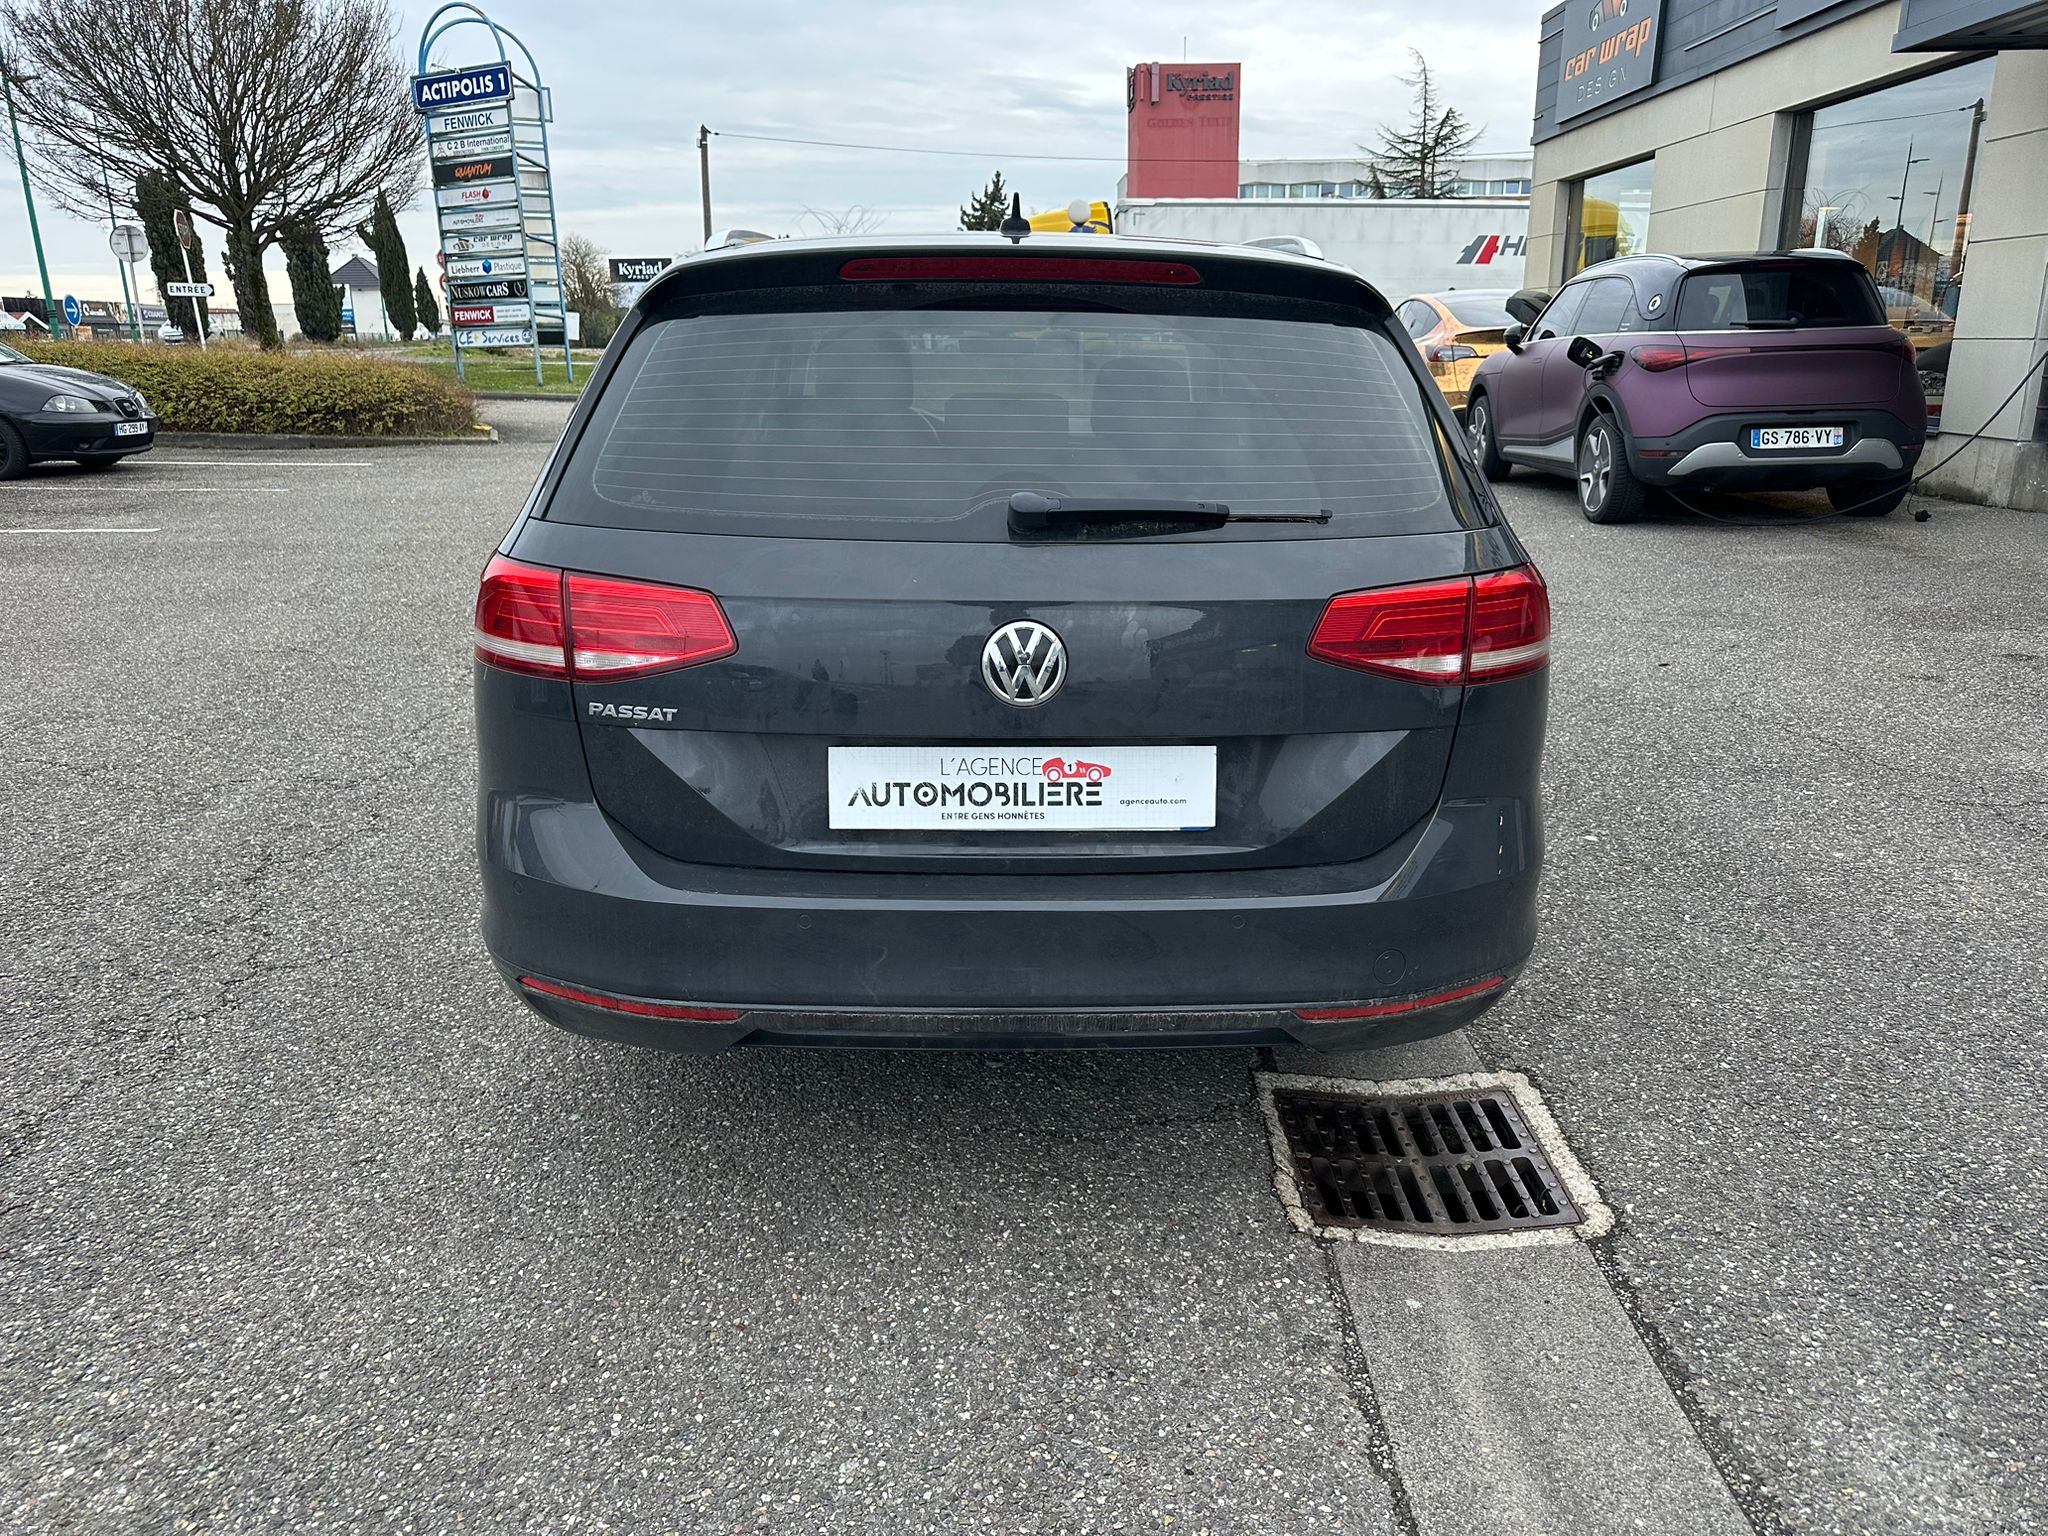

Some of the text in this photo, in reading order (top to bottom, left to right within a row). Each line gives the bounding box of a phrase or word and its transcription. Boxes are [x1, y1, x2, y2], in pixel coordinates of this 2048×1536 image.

[1564, 16, 1652, 81] car wrap
[421, 73, 506, 102] ACTIPOLIS 1
[1167, 71, 1233, 96] Kyriad
[1577, 65, 1627, 102] DESIGN
[444, 112, 494, 131] FENWICK
[467, 135, 510, 147] International
[454, 163, 492, 178] QUANTUM
[462, 188, 481, 199] FLASH
[473, 233, 513, 243] car wrap
[1499, 235, 1528, 256] H
[451, 265, 480, 275] Liebherr
[618, 261, 663, 279] Kyriad
[170, 284, 206, 294] ENTRÉE
[454, 310, 492, 321] FENWICK
[482, 331, 520, 344] Services
[1761, 429, 1832, 445] GS-786-VY
[588, 702, 678, 722] PASSAT
[1119, 798, 1187, 807] agenceauto.com
[941, 810, 1045, 820] ENTRE GENS HONNÊTES
